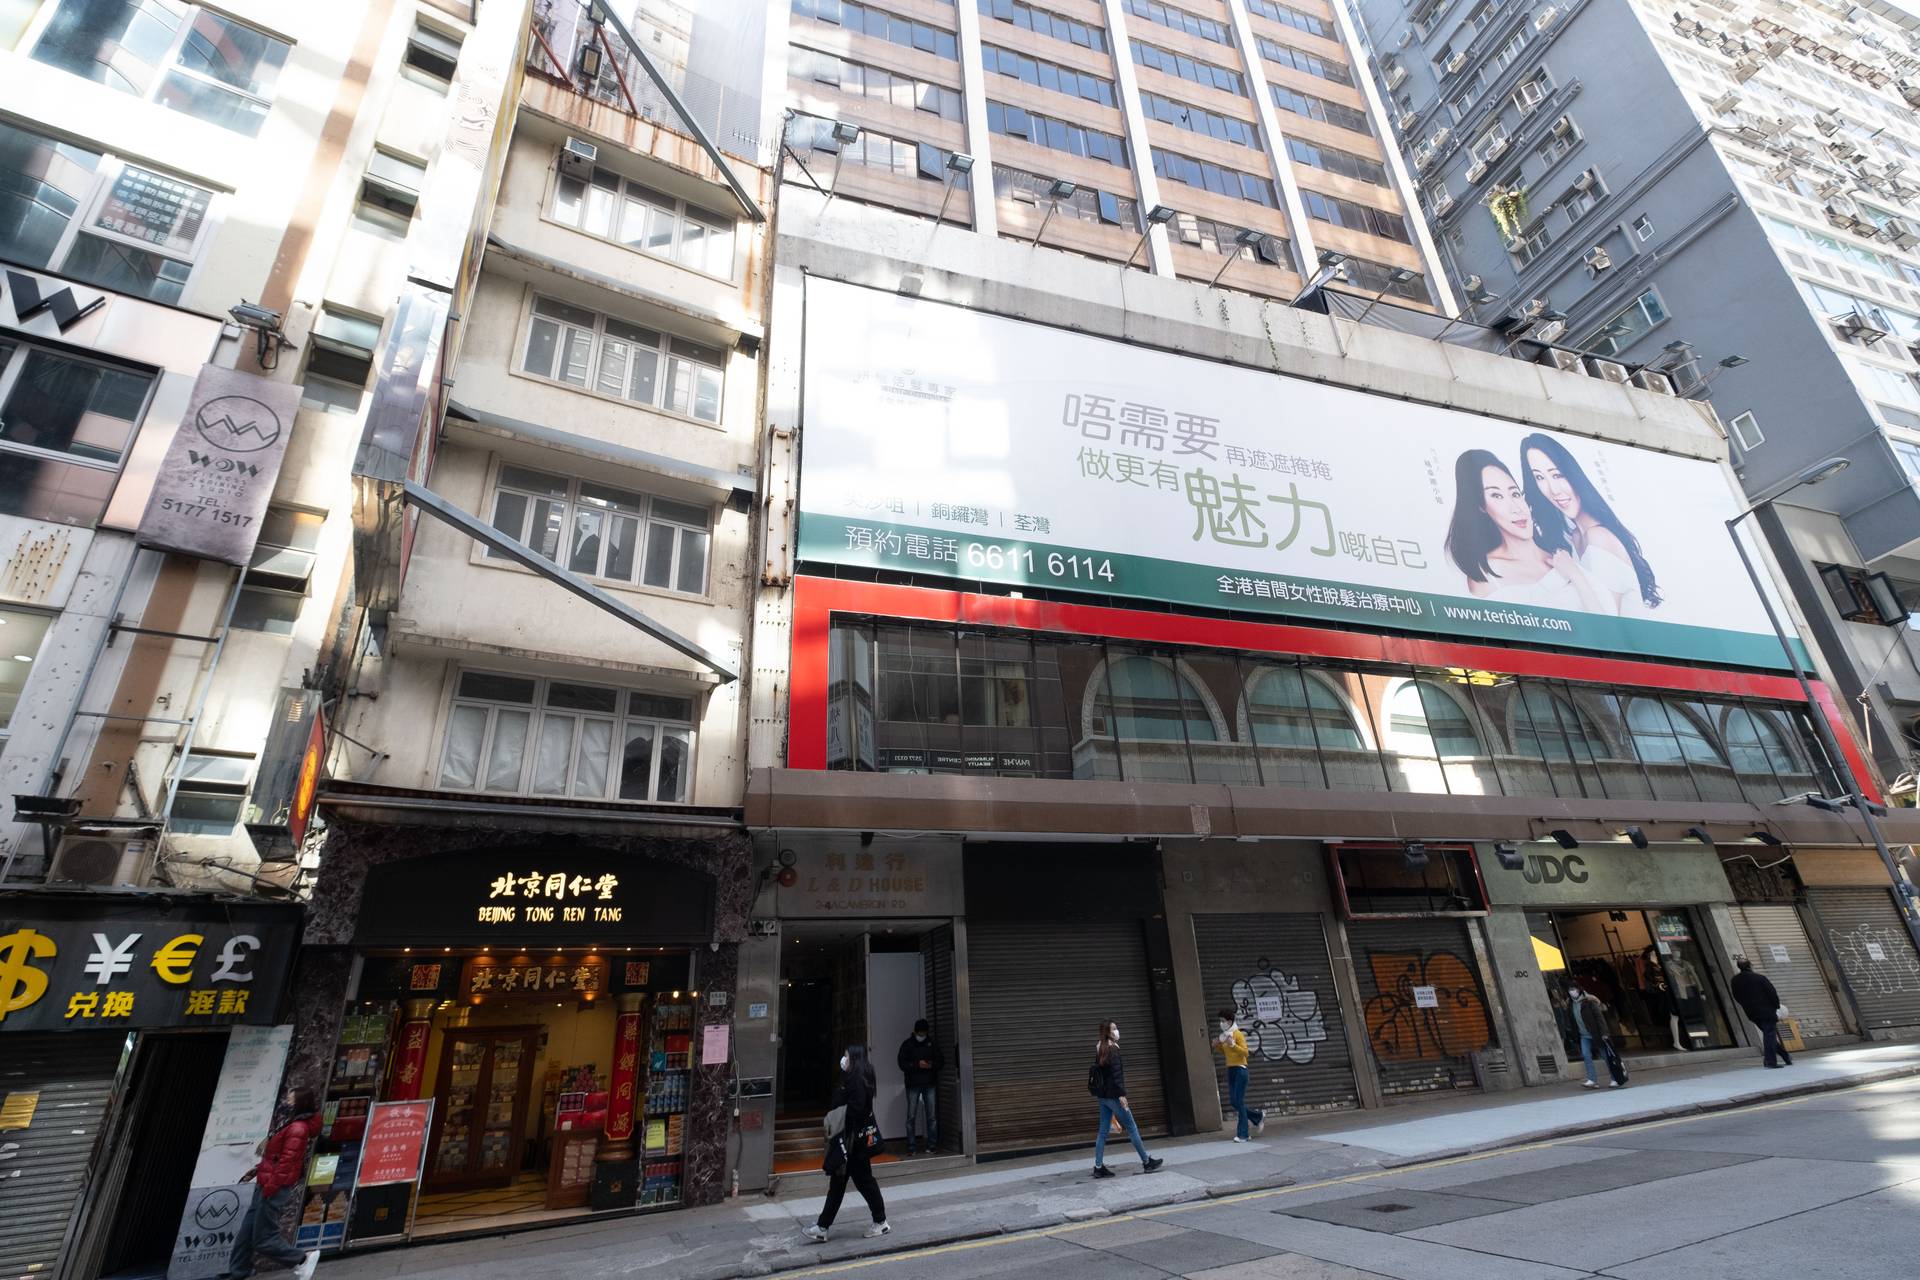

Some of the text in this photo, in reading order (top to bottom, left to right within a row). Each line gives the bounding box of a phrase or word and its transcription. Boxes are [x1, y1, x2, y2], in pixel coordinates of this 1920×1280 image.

[0, 270, 105, 333] W
[1062, 393, 1333, 481] 唔需要 再遮遮掩掩
[188, 450, 264, 477] WOW
[161, 498, 253, 528] 5177 1517
[931, 502, 989, 526] 銅鑼灣
[1014, 513, 1050, 535] 荃灣
[1076, 446, 1427, 569] 做更有 魅力 嘅自己
[844, 525, 1115, 582] 預約電話 6611 6114
[1216, 575, 1572, 631] 全港首間女性脫髮治療中心 www.terishair.com
[1523, 854, 1589, 884] JDC
[489, 871, 619, 900] 北京同仁堂
[868, 877, 925, 892] HOUSE
[478, 906, 622, 924] BEIJING TONG REN TANG
[471, 966, 591, 994] 北京同仁堂
[1514, 970, 1528, 978] JDC
